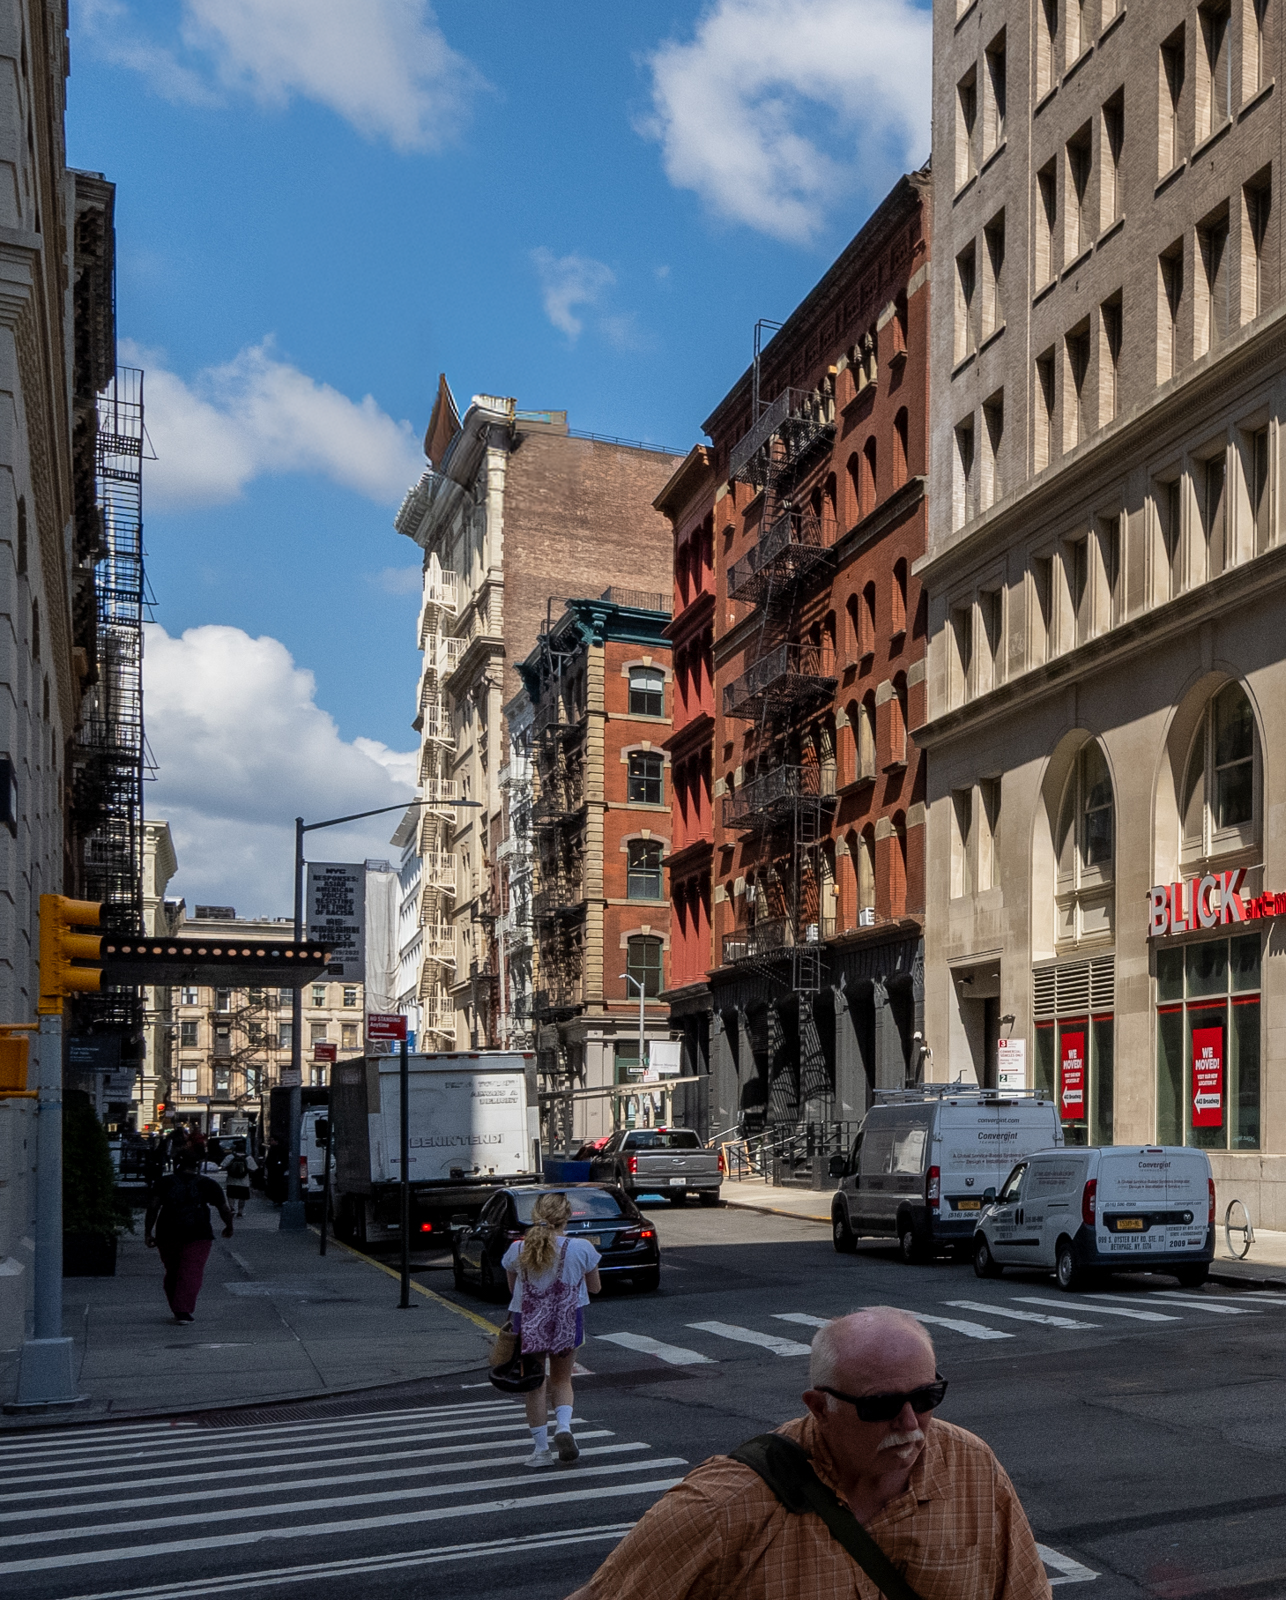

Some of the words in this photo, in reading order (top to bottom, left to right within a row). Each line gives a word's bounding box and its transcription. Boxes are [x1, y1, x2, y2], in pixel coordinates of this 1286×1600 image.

[1150, 868, 1248, 936] BLICK
[1246, 892, 1274, 920] art
[1068, 1049, 1077, 1059] WE
[1202, 1047, 1213, 1058] WE
[1063, 1059, 1082, 1070] MOVED!
[1195, 1059, 1220, 1070] MOVED!
[1203, 1098, 1219, 1106] Broadway
[978, 1132, 1018, 1141] Convergint
